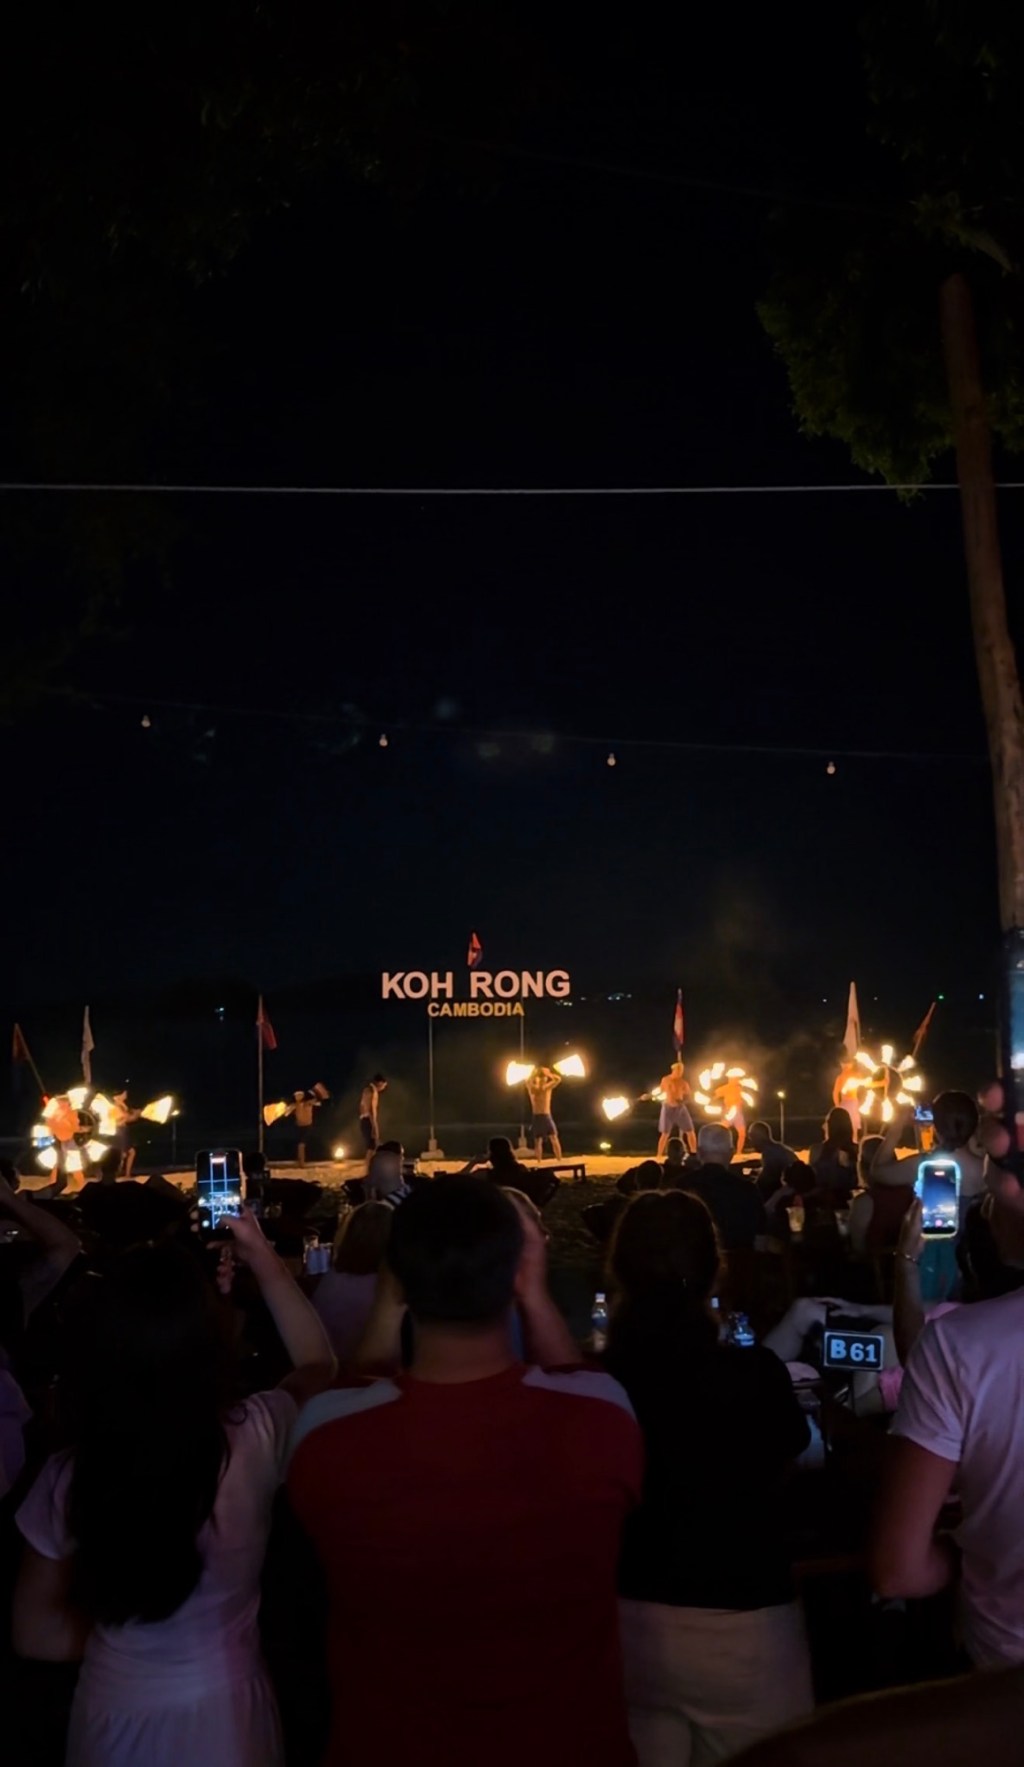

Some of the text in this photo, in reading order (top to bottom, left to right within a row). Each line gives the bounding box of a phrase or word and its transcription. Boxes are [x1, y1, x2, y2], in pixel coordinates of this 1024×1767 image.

[381, 970, 571, 999] KOH RONG
[427, 1002, 525, 1018] CAMBODIA
